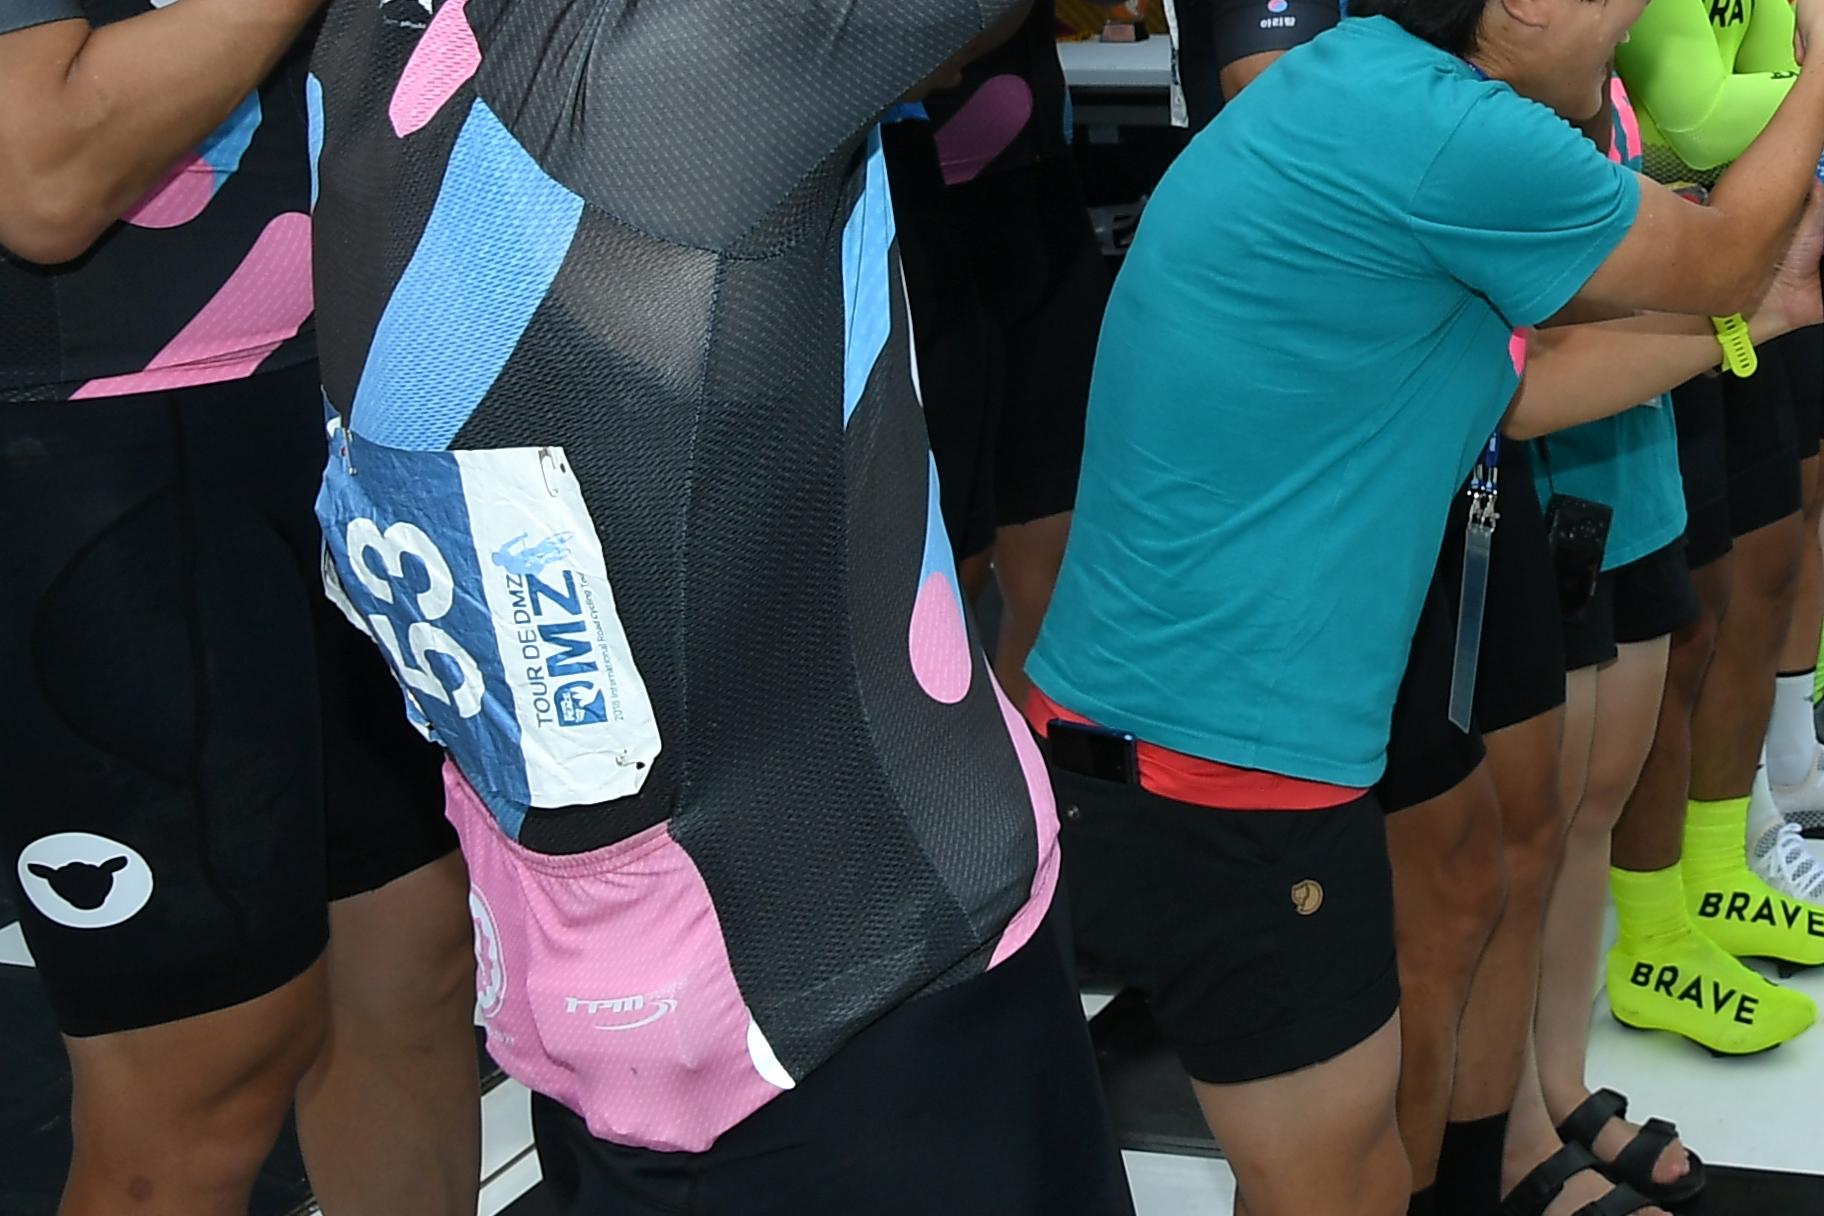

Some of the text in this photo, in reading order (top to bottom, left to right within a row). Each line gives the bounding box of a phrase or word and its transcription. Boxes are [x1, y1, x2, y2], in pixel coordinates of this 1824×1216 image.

[346, 517, 485, 718] 53
[507, 573, 553, 728] TOUR DE DMZ
[525, 569, 608, 728] DMZ
[1629, 961, 1760, 1026] BRAVE
